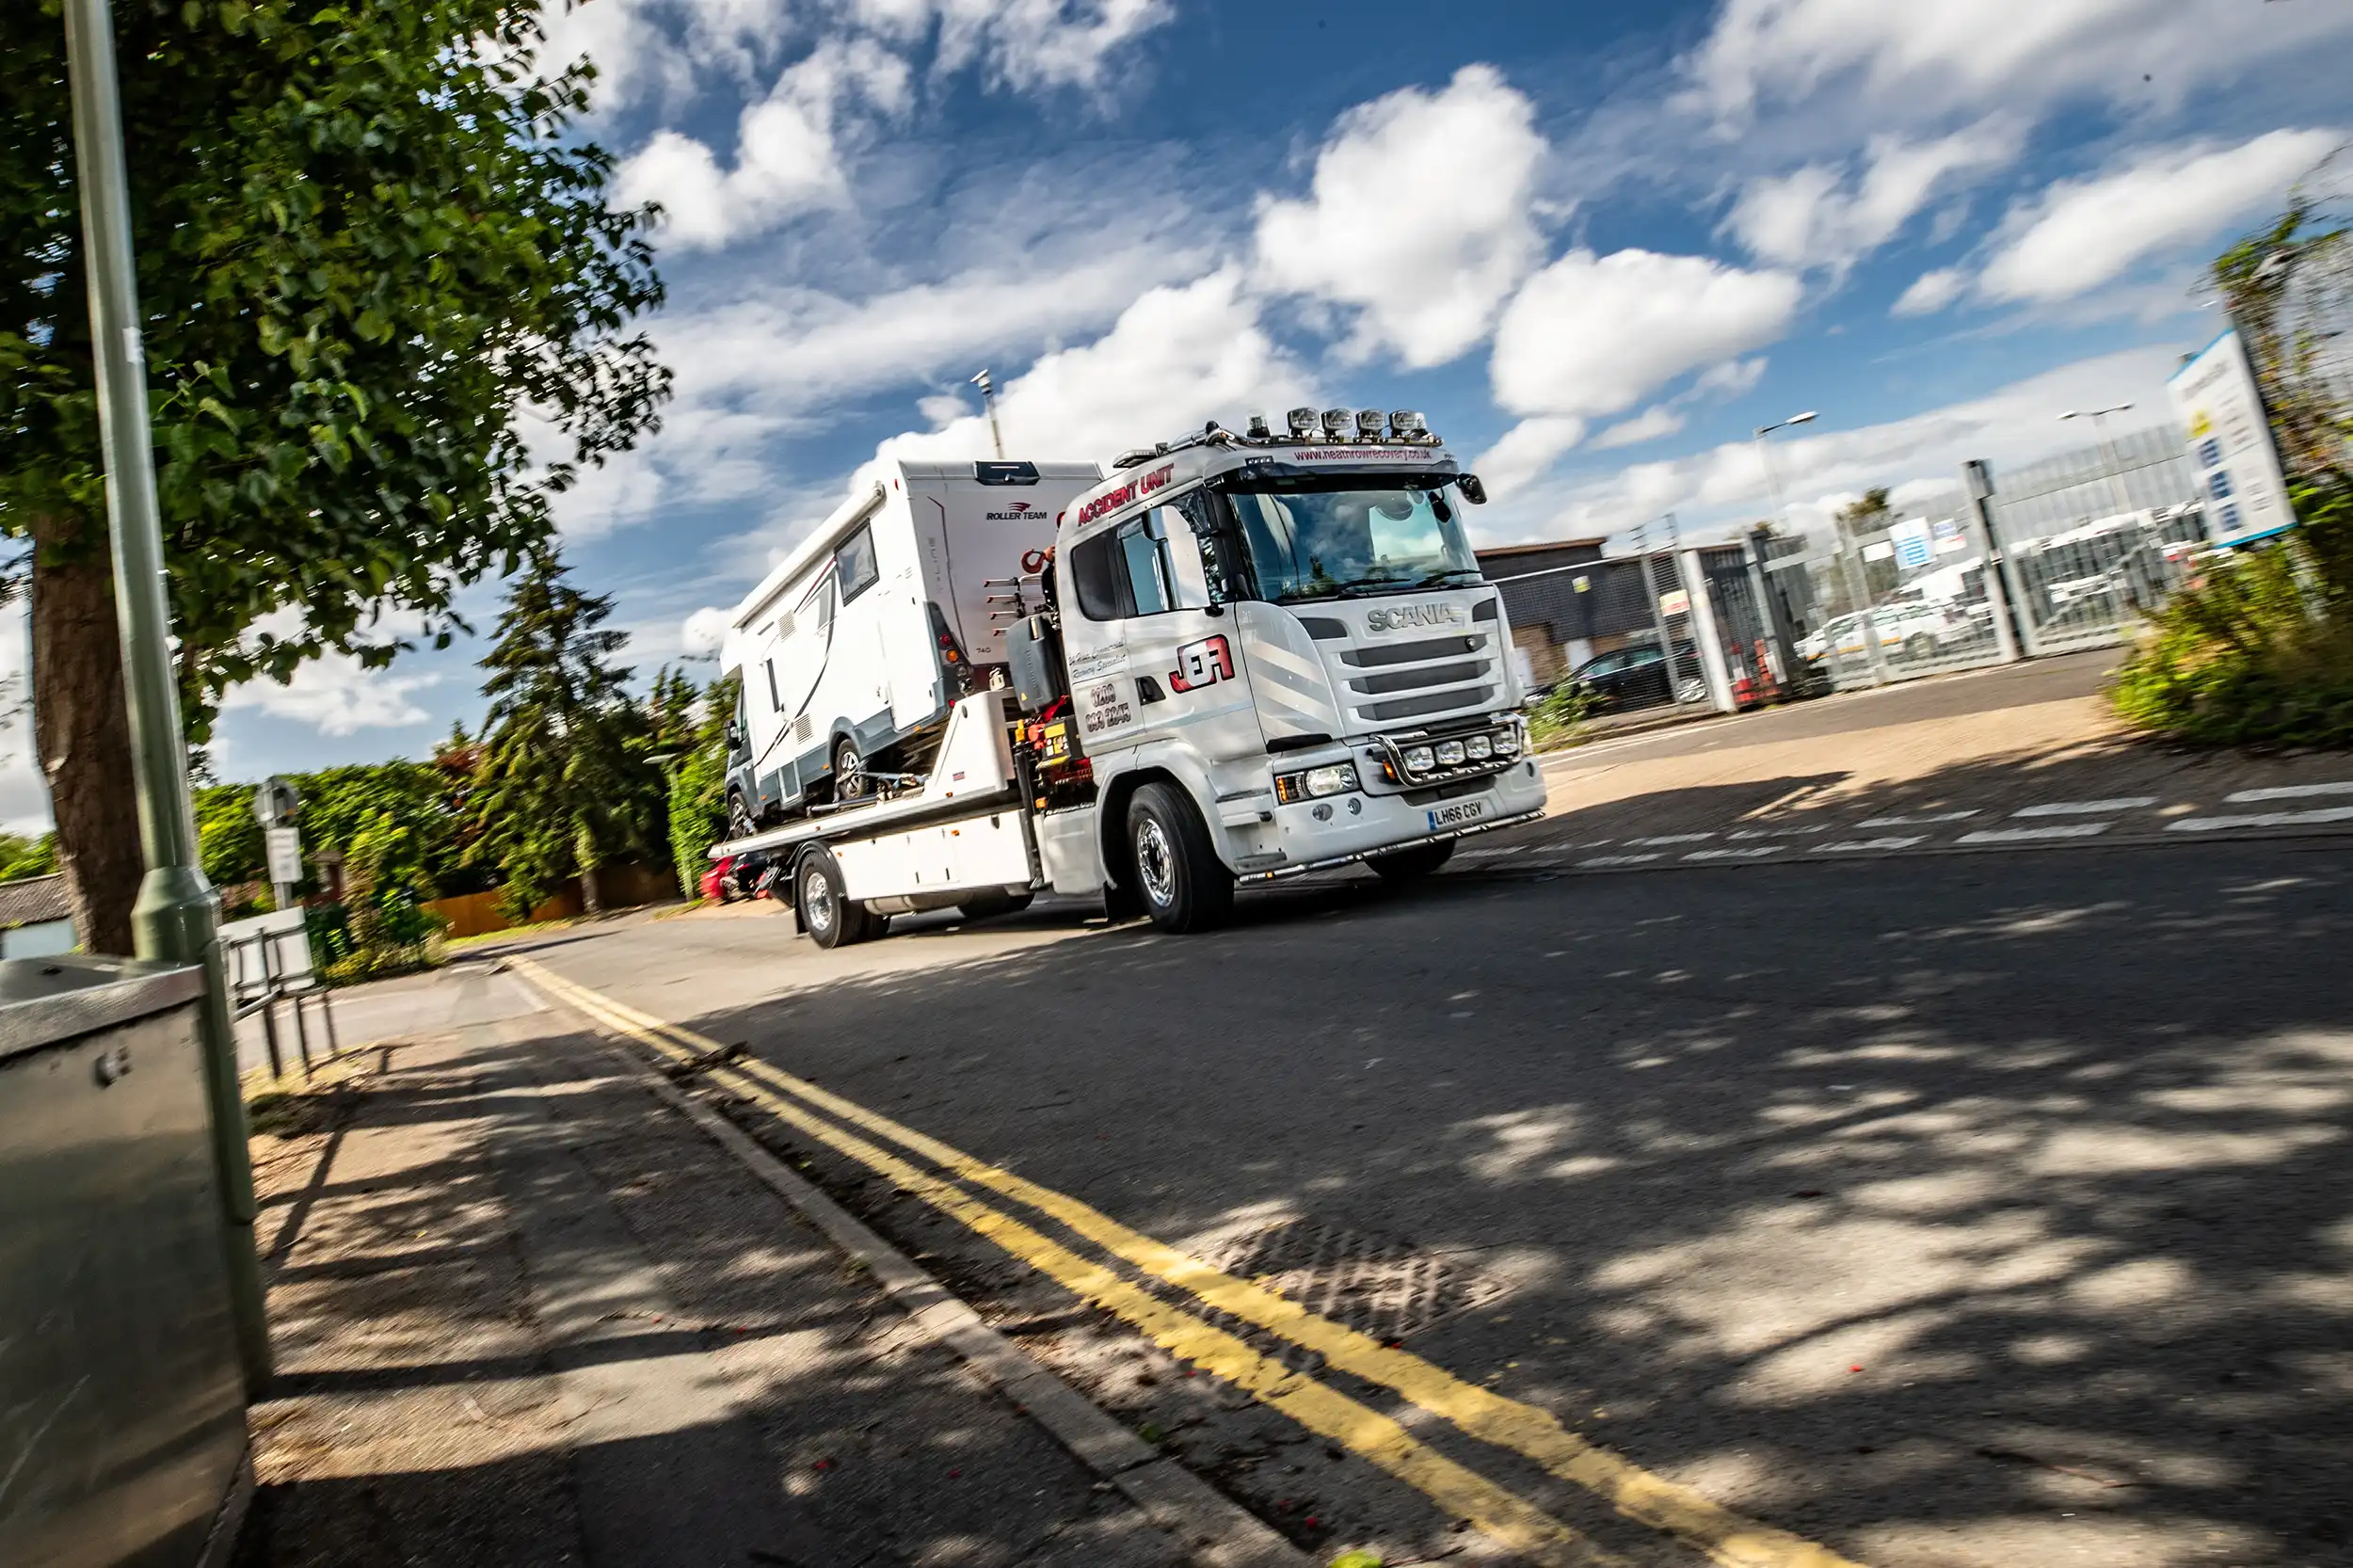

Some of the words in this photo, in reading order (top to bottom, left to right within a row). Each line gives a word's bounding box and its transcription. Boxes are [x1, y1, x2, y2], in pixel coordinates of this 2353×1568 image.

[1294, 448, 1432, 462] www.heathrowrecovery.co.uk
[1078, 482, 1139, 527] ACCIDENT
[1141, 463, 1175, 495] UNIT
[986, 512, 1021, 520] ROLLER
[1023, 511, 1048, 520] TEAM
[1368, 602, 1455, 632] SCANIA
[1091, 683, 1116, 708] 0208
[1434, 805, 1462, 825] LH66
[1462, 801, 1483, 819] CGV
